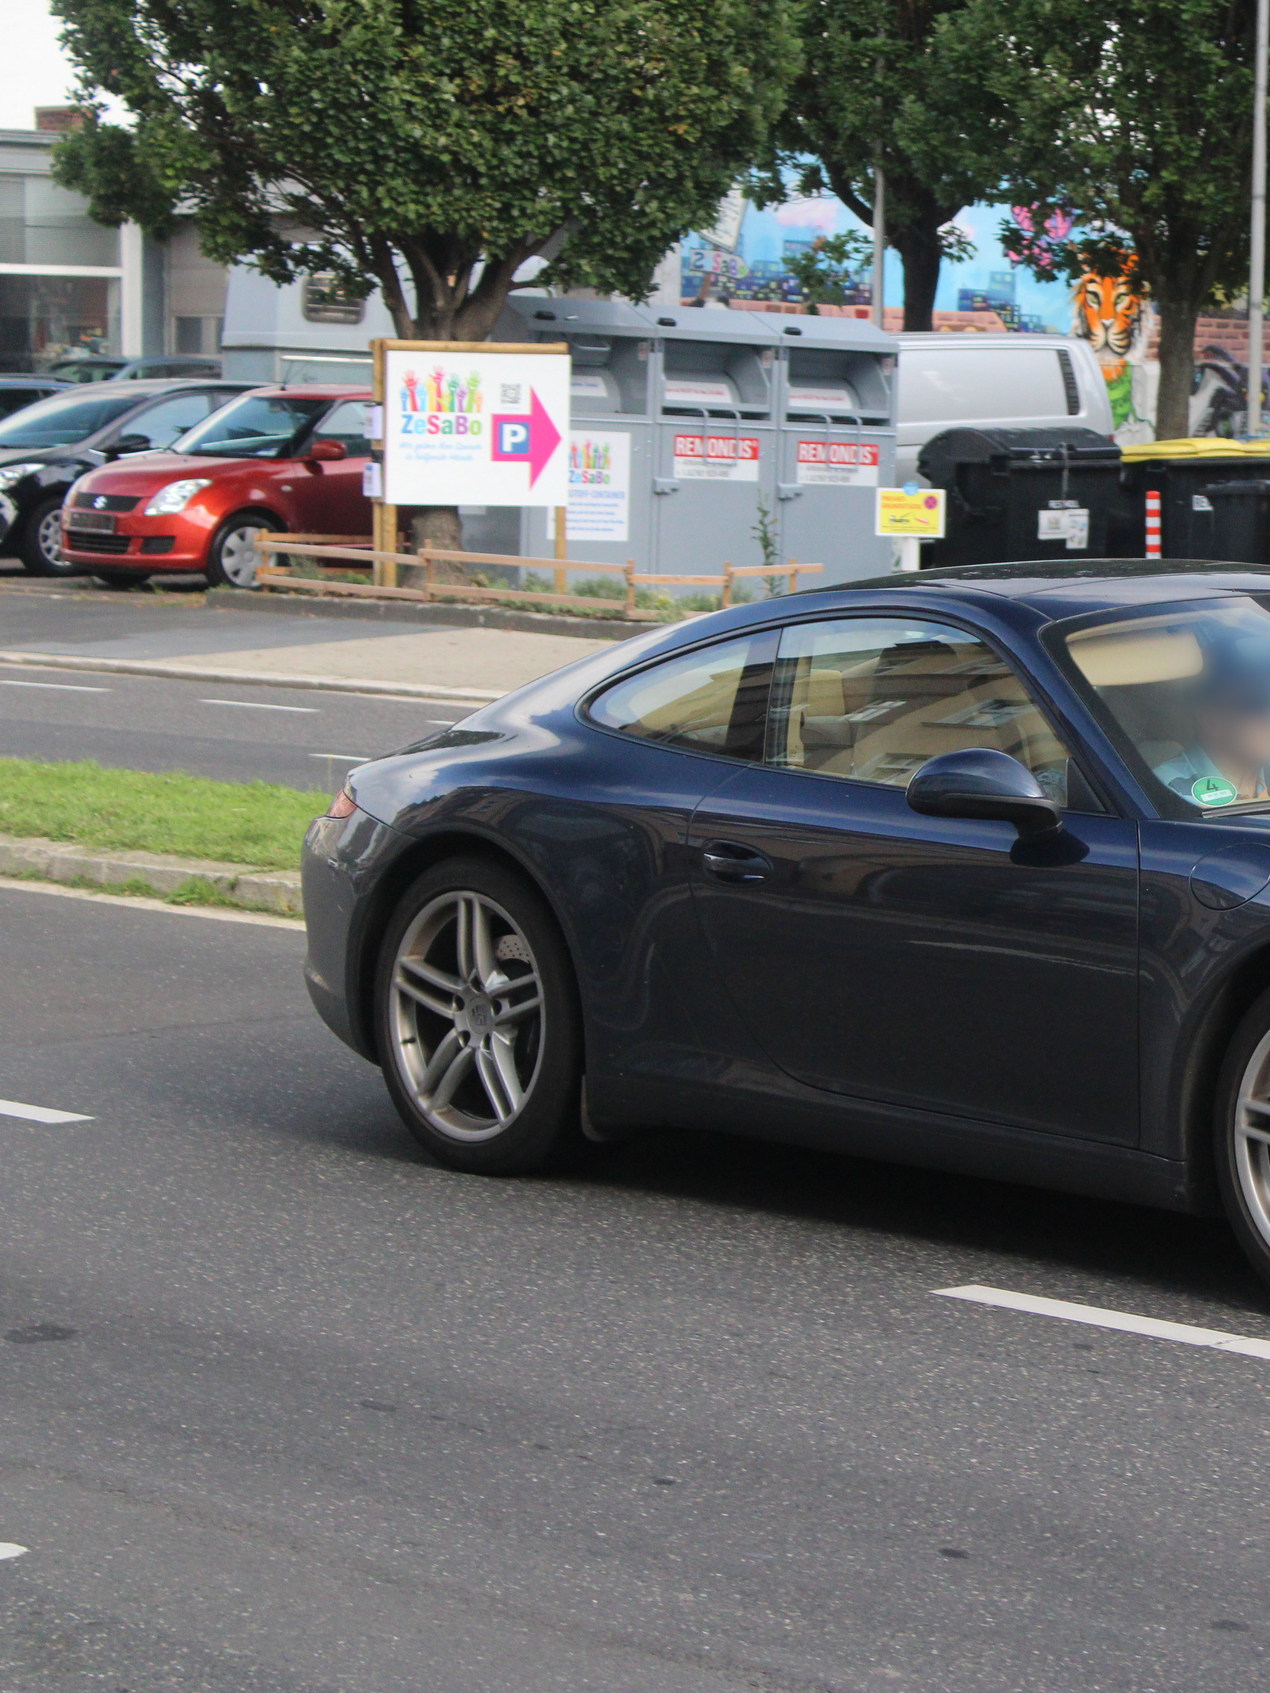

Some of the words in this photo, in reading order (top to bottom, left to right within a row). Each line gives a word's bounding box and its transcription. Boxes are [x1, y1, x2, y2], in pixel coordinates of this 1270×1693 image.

[401, 414, 482, 436] ZeSaBo
[502, 424, 527, 452] P
[569, 470, 610, 484] ZeSaBo
